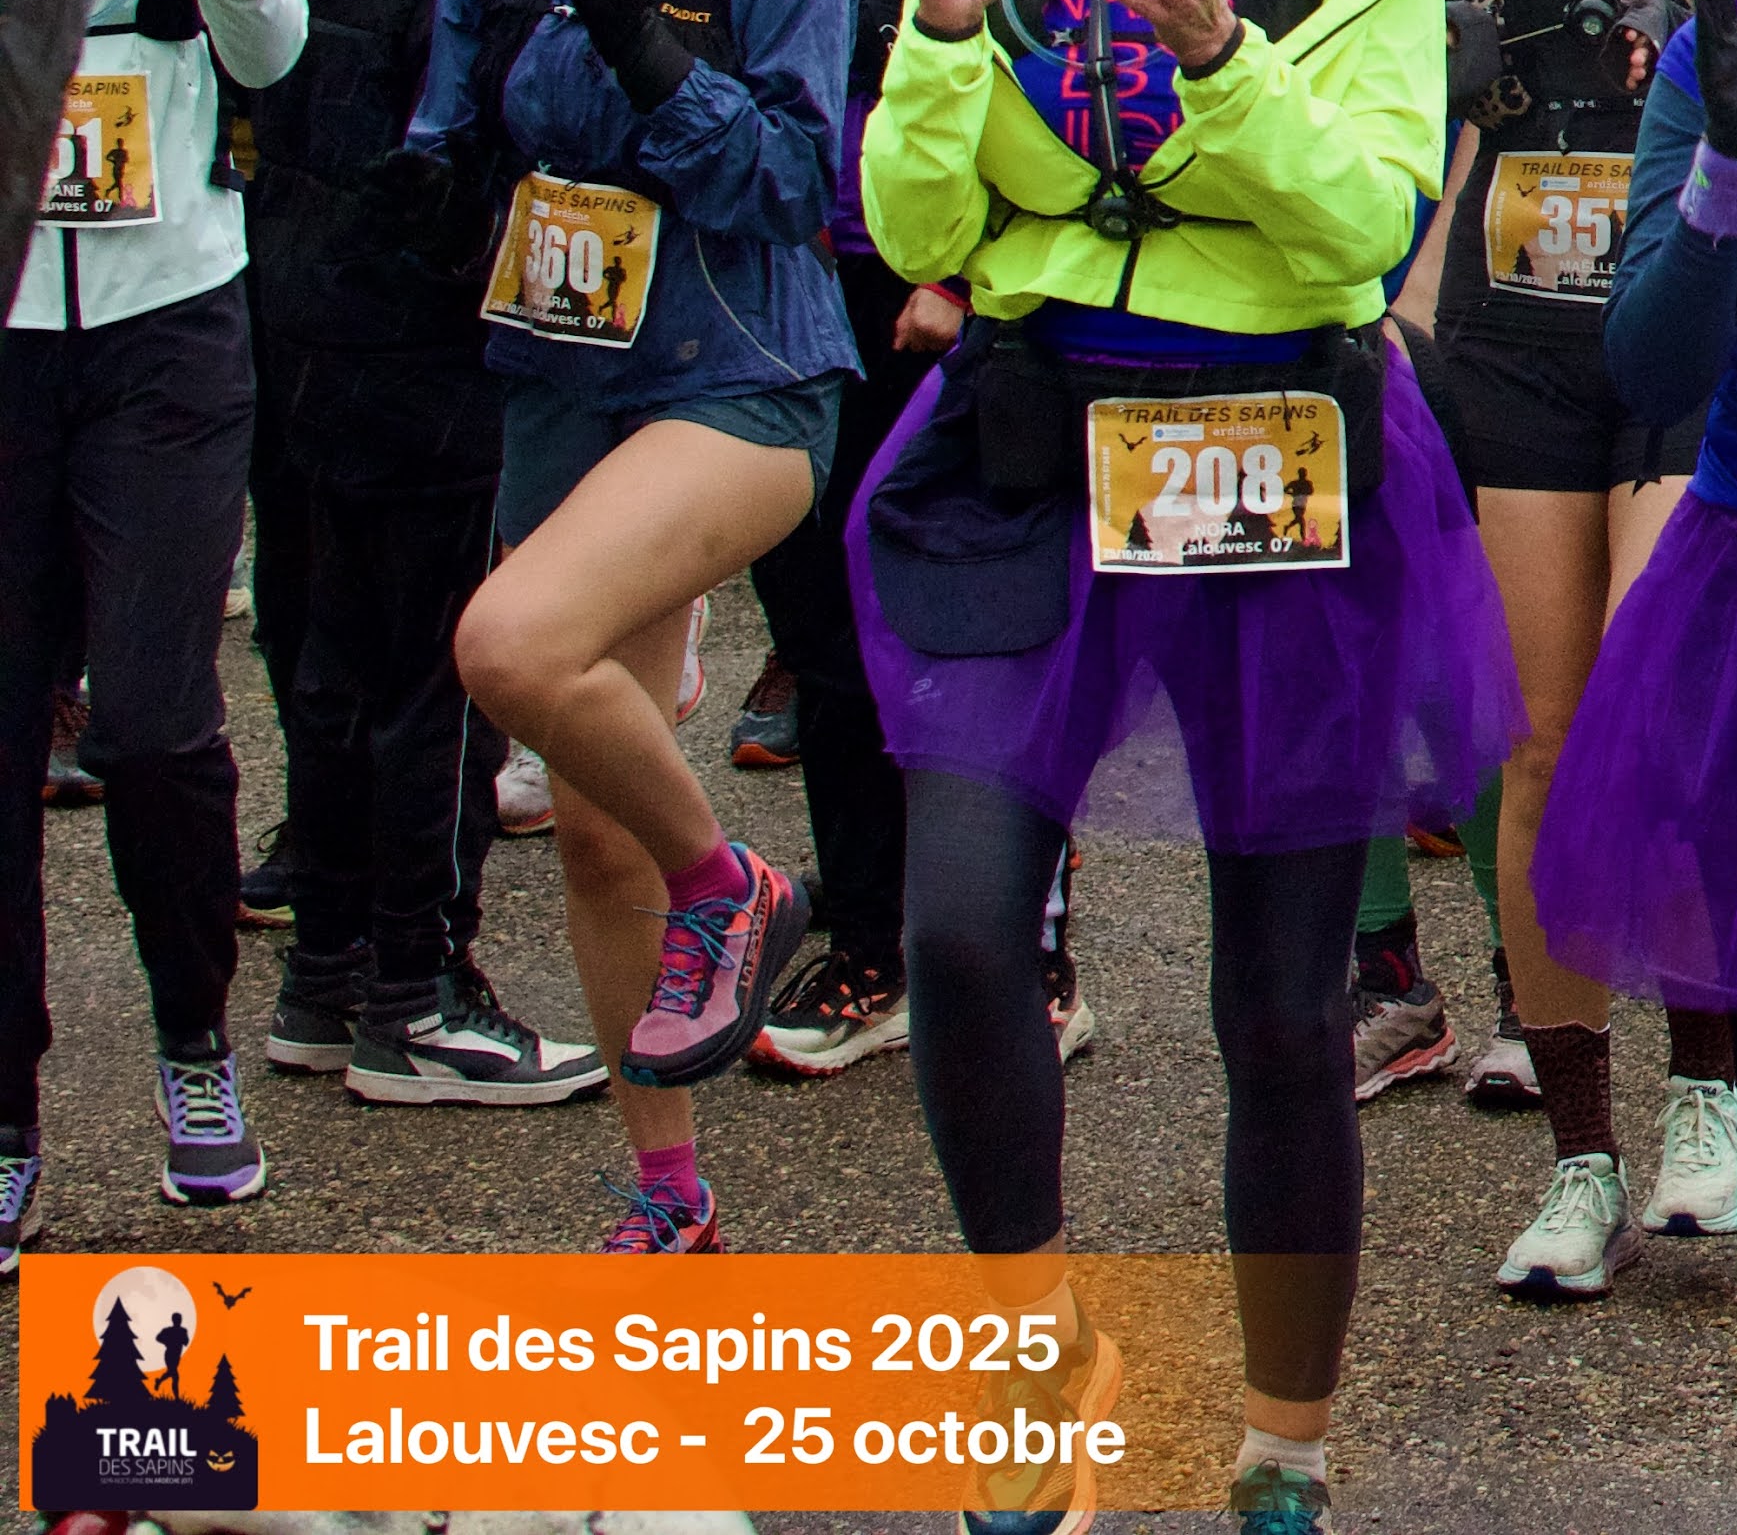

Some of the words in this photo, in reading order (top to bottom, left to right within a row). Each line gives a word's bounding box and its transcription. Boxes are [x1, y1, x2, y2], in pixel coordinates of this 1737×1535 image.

[661, 3, 712, 24] EVADICT
[71, 81, 131, 96] SAPINS
[1521, 162, 1565, 177] TRAIL
[1568, 162, 1604, 178] DES
[94, 200, 113, 213] 07
[570, 194, 637, 214] SAPINS
[526, 219, 604, 294] 360
[1556, 273, 1615, 289] Lalouves
[586, 315, 606, 329] 07
[1124, 407, 1184, 424] TRAIL
[1189, 407, 1231, 424] DES
[1239, 404, 1318, 423] SAPNS
[1151, 444, 1285, 518] 208
[1194, 521, 1246, 537] NORA
[1180, 539, 1263, 556] Lalouvesc
[1269, 538, 1293, 554] 07
